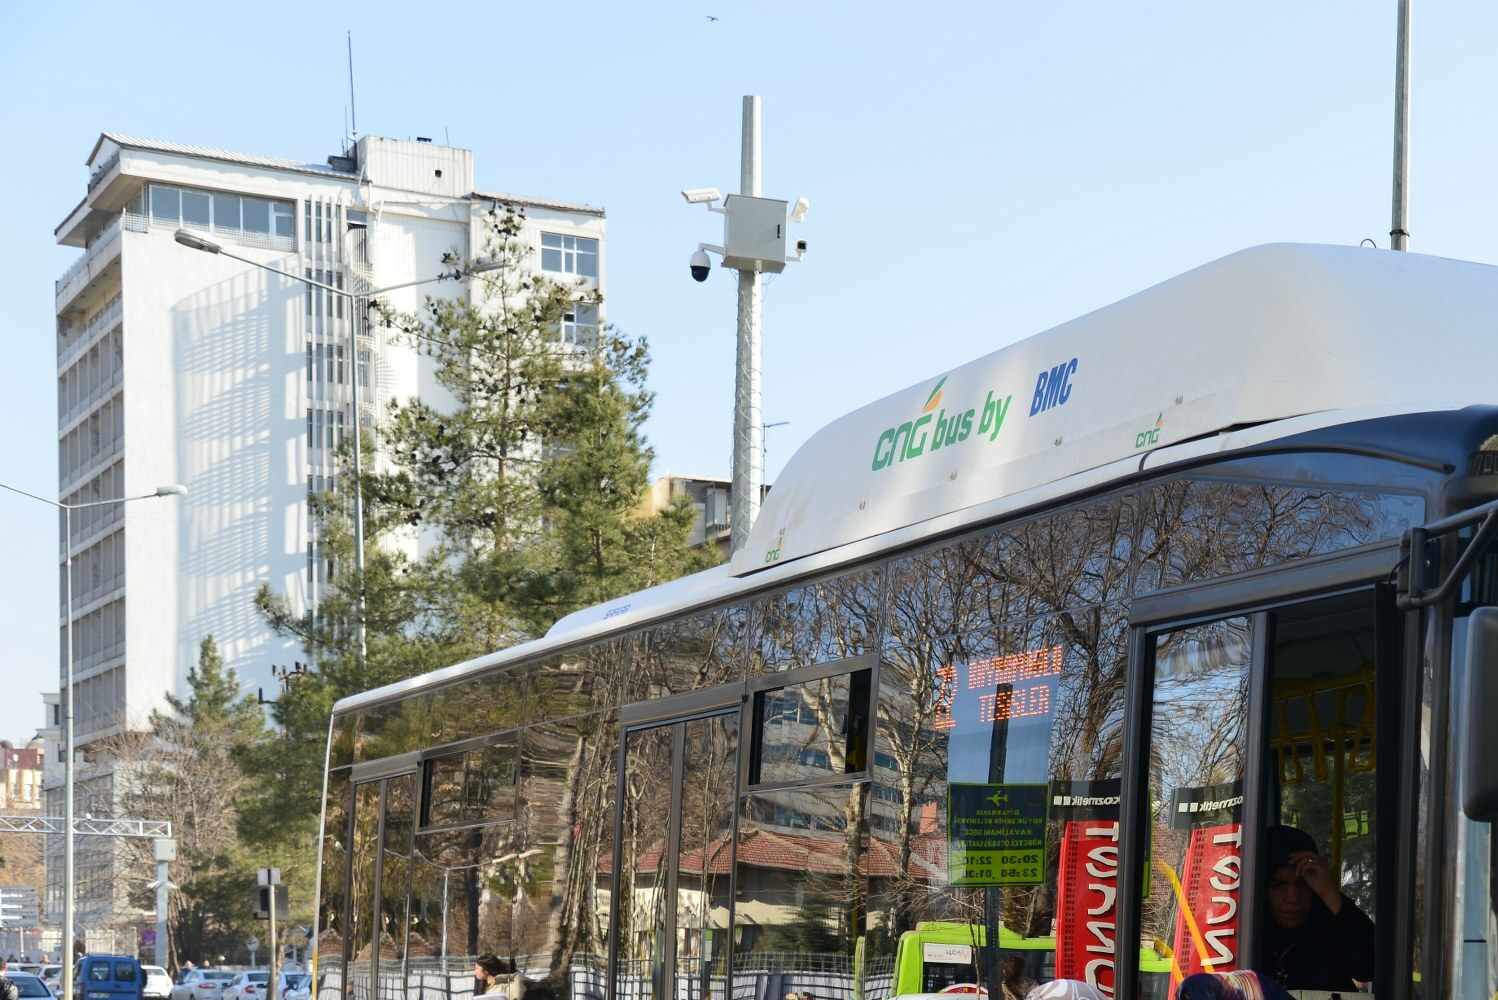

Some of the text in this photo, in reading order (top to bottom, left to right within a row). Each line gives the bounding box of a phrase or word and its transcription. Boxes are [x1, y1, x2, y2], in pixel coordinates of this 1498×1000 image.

[930, 408, 976, 452] bus
[977, 390, 1012, 442] by
[1029, 357, 1078, 418] BMC
